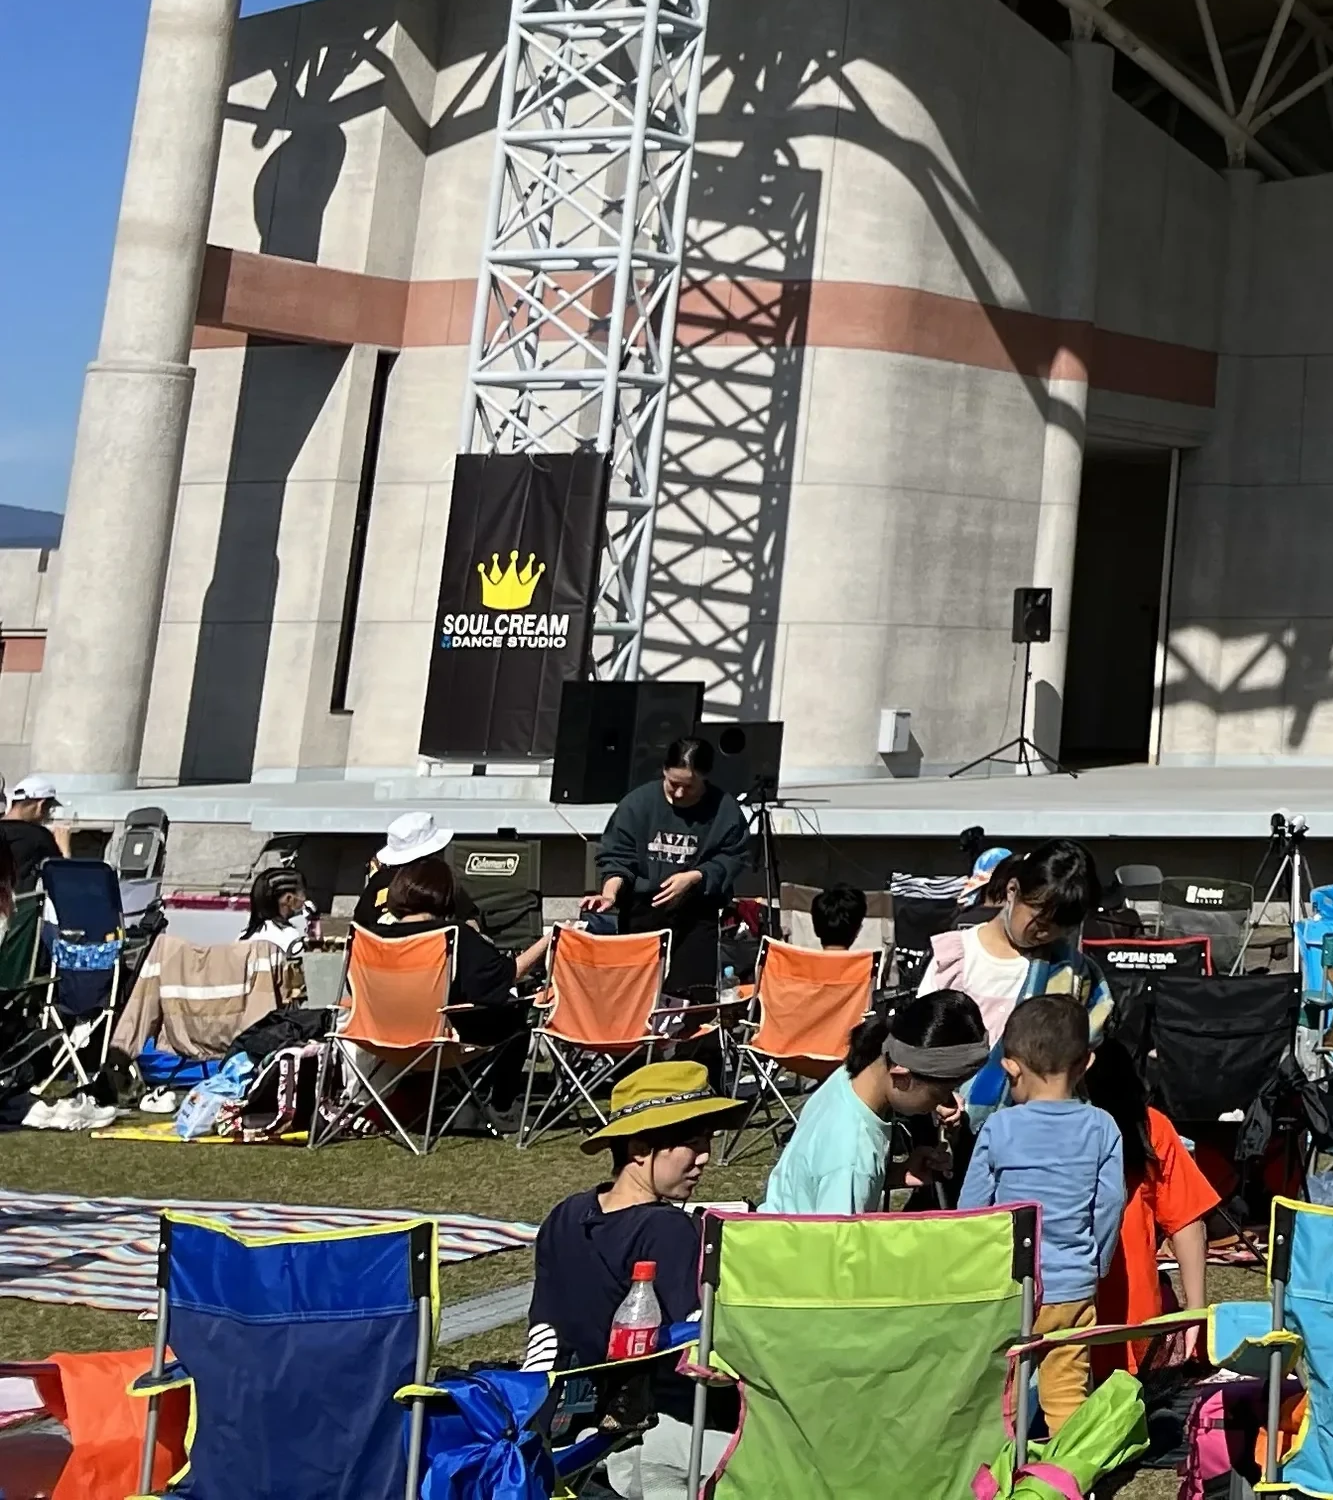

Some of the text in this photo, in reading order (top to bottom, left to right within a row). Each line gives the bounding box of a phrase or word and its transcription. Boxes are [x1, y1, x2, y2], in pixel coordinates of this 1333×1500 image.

[442, 613, 570, 636] SOULCREAM
[452, 635, 567, 649] DANCE STUDIO
